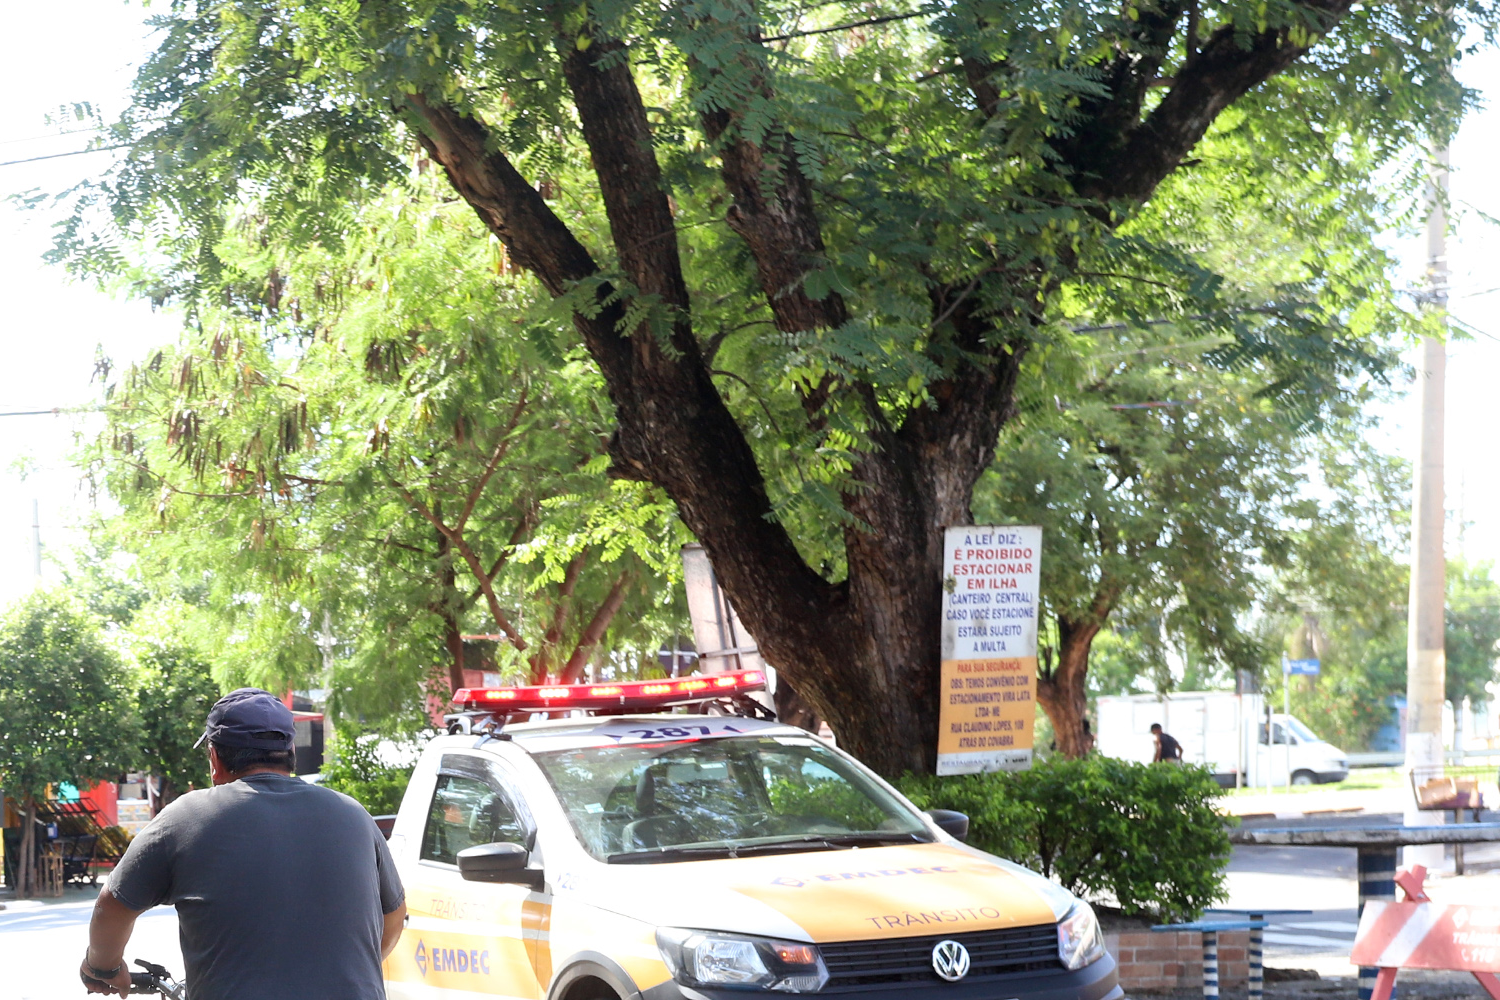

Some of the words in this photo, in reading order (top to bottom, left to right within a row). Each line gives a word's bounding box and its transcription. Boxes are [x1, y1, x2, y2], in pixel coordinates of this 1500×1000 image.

[965, 535, 972, 545] A
[976, 534, 992, 544] LEI
[954, 547, 962, 560] É
[967, 548, 1032, 560] PROIBIDO
[954, 563, 1032, 575] ESTACIONAR
[968, 578, 984, 589] EM
[990, 578, 1017, 589] ILHA
[996, 592, 1032, 604] CENTRAL)
[946, 609, 968, 620] CASO
[970, 606, 990, 620] VOCÊ
[992, 607, 1034, 619] ESTACIONE
[990, 625, 1022, 636] SUJEITO
[974, 642, 979, 652] A
[980, 641, 1006, 652] MULTA
[957, 663, 972, 672] PARA
[974, 662, 984, 672] SUA
[966, 678, 984, 688] TEMOS
[1016, 676, 1028, 686] COM
[950, 692, 1000, 704] ESTACIONAMENTO
[1003, 691, 1015, 702] VIRA
[1016, 690, 1030, 701] LATA
[628, 725, 711, 739] 287
[816, 866, 958, 882] EMDEC
[865, 906, 1000, 930] TRÂNSITO
[432, 947, 490, 975] EMDEC
